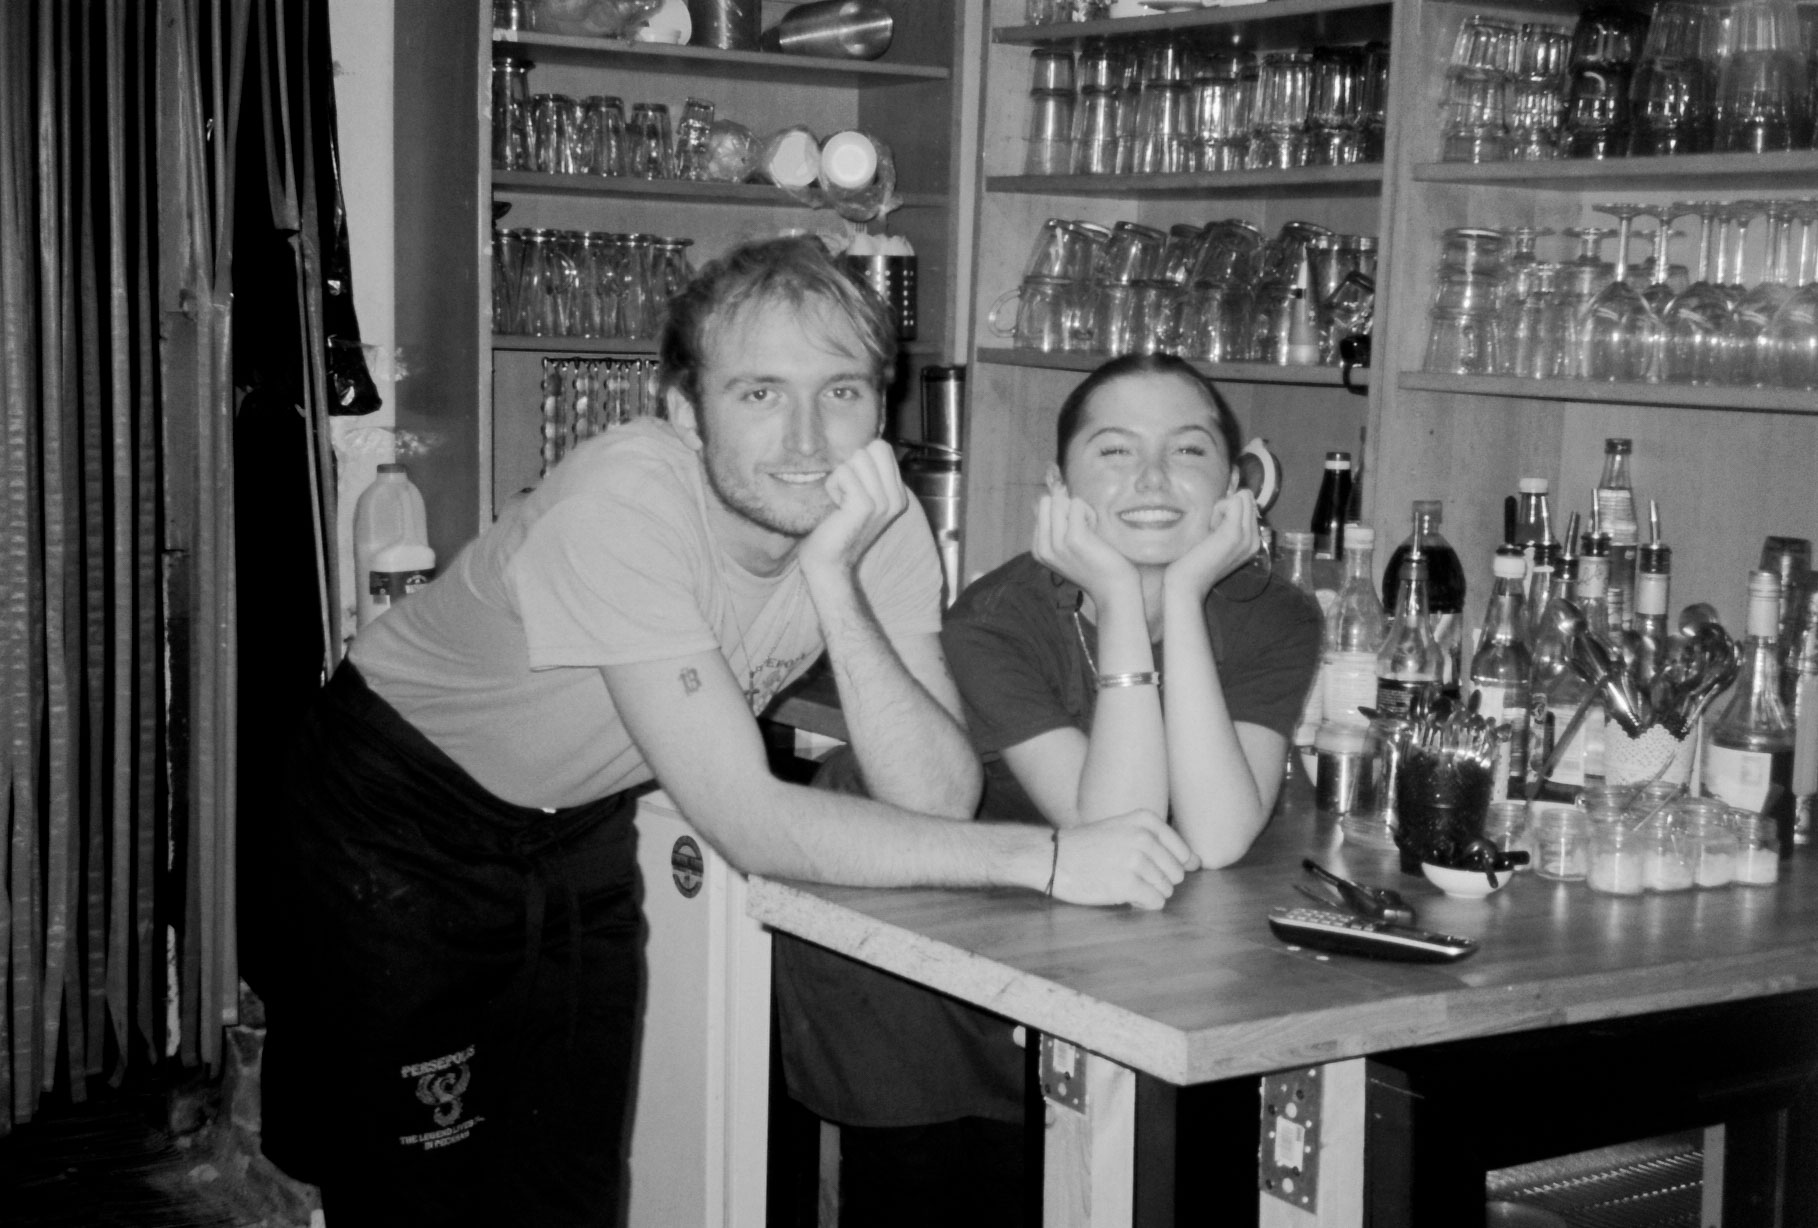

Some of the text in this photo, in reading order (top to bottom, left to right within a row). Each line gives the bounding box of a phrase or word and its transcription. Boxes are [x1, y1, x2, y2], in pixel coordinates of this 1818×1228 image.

[401, 1044, 475, 1078] PERSEPOLS
[399, 1135, 418, 1145] THE
[419, 1127, 453, 1142] LEGEND
[424, 1141, 434, 1150] IN
